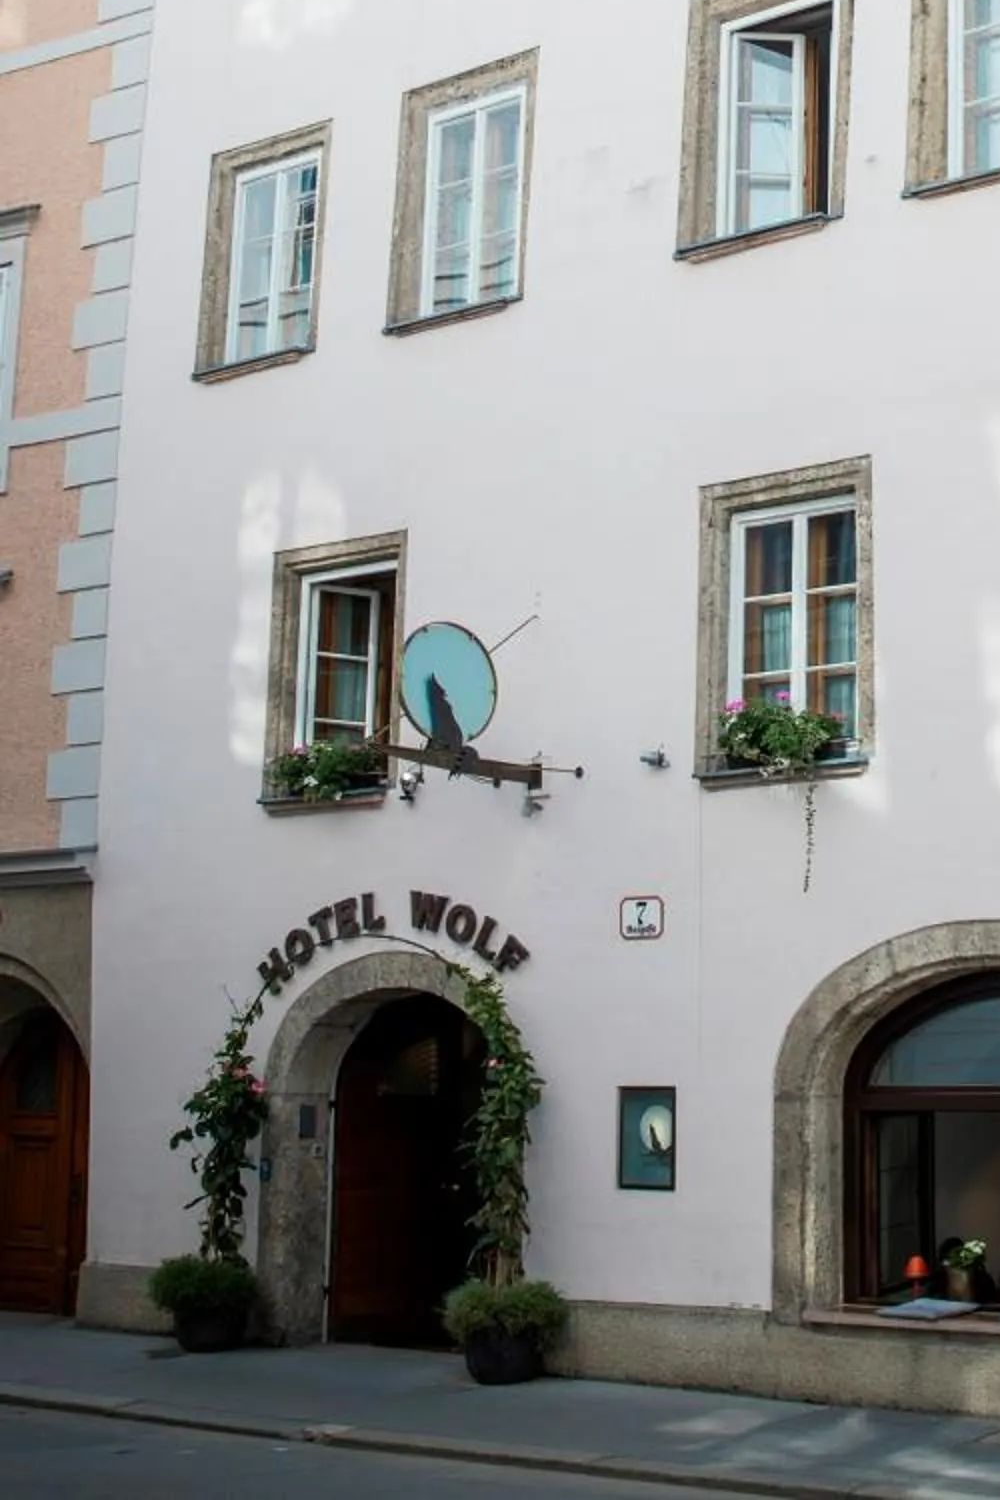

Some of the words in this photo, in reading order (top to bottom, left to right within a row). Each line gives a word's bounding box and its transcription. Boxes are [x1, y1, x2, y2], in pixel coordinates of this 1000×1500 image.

[256, 891, 387, 983] HOTEL
[410, 889, 530, 972] WOLF
[636, 901, 647, 925] 7
